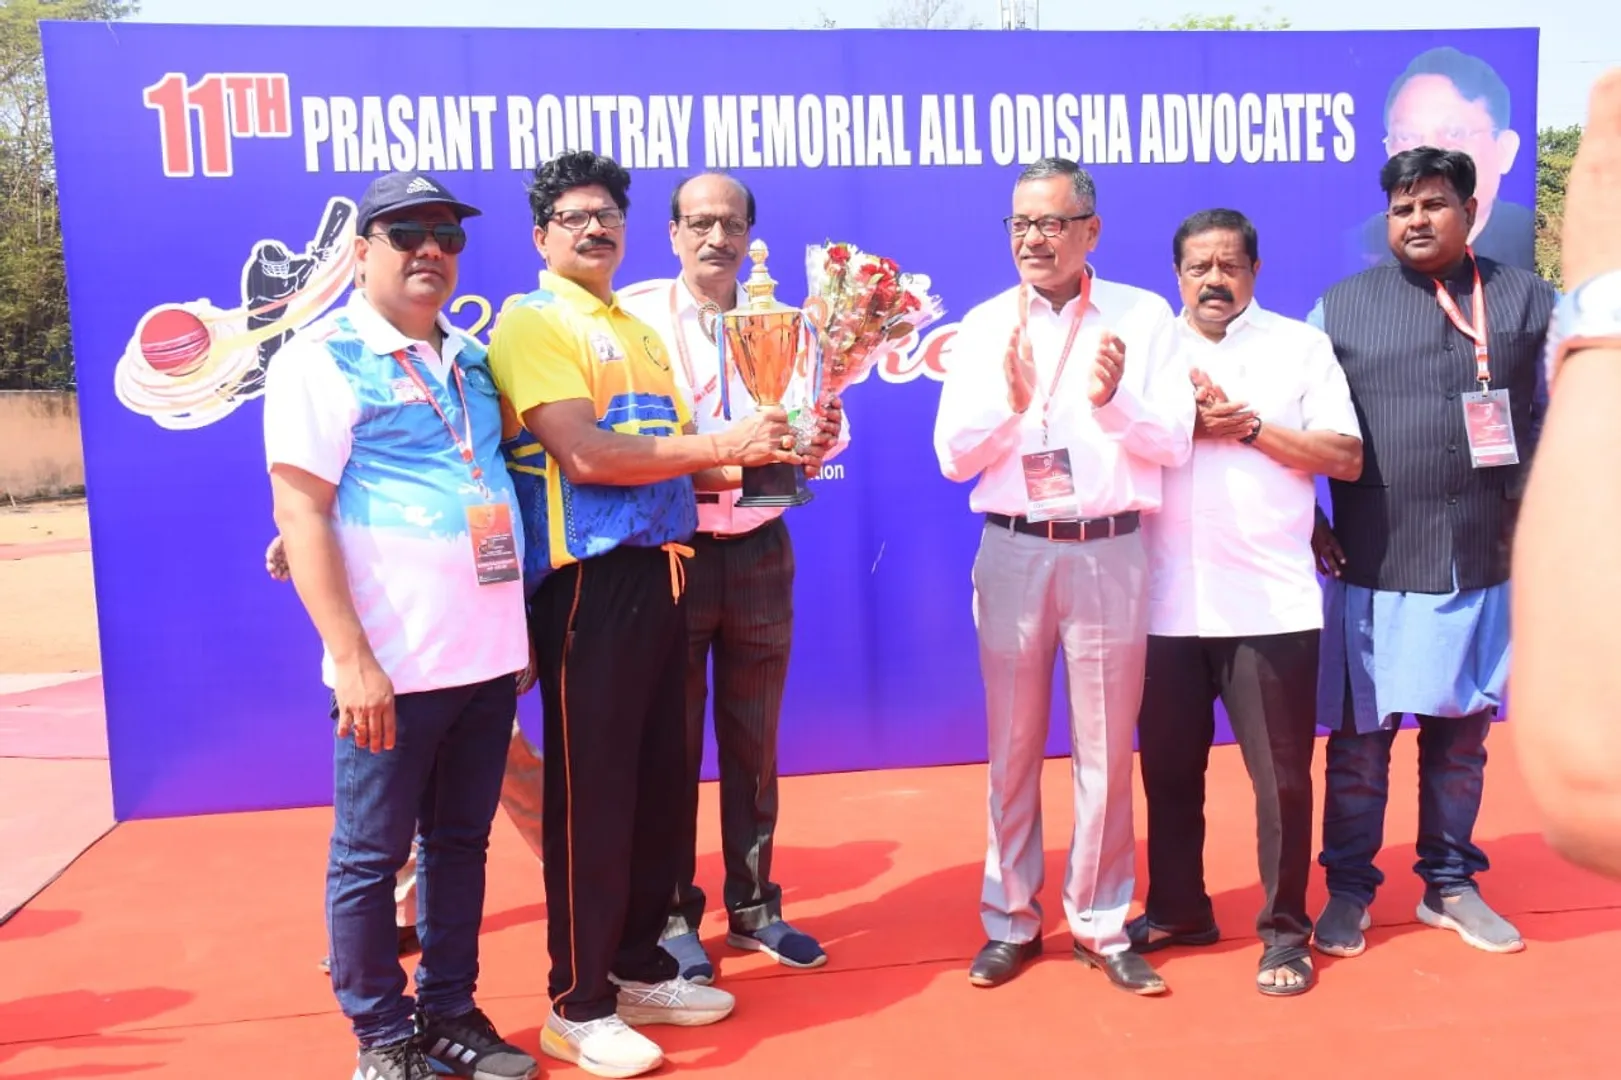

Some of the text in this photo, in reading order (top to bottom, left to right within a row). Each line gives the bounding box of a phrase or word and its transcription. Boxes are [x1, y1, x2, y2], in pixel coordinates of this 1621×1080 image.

[143, 72, 1355, 177] 11TH PRASANT ROUTRAY MEMORIAL ALL ODISHA ADVOCATE'S
